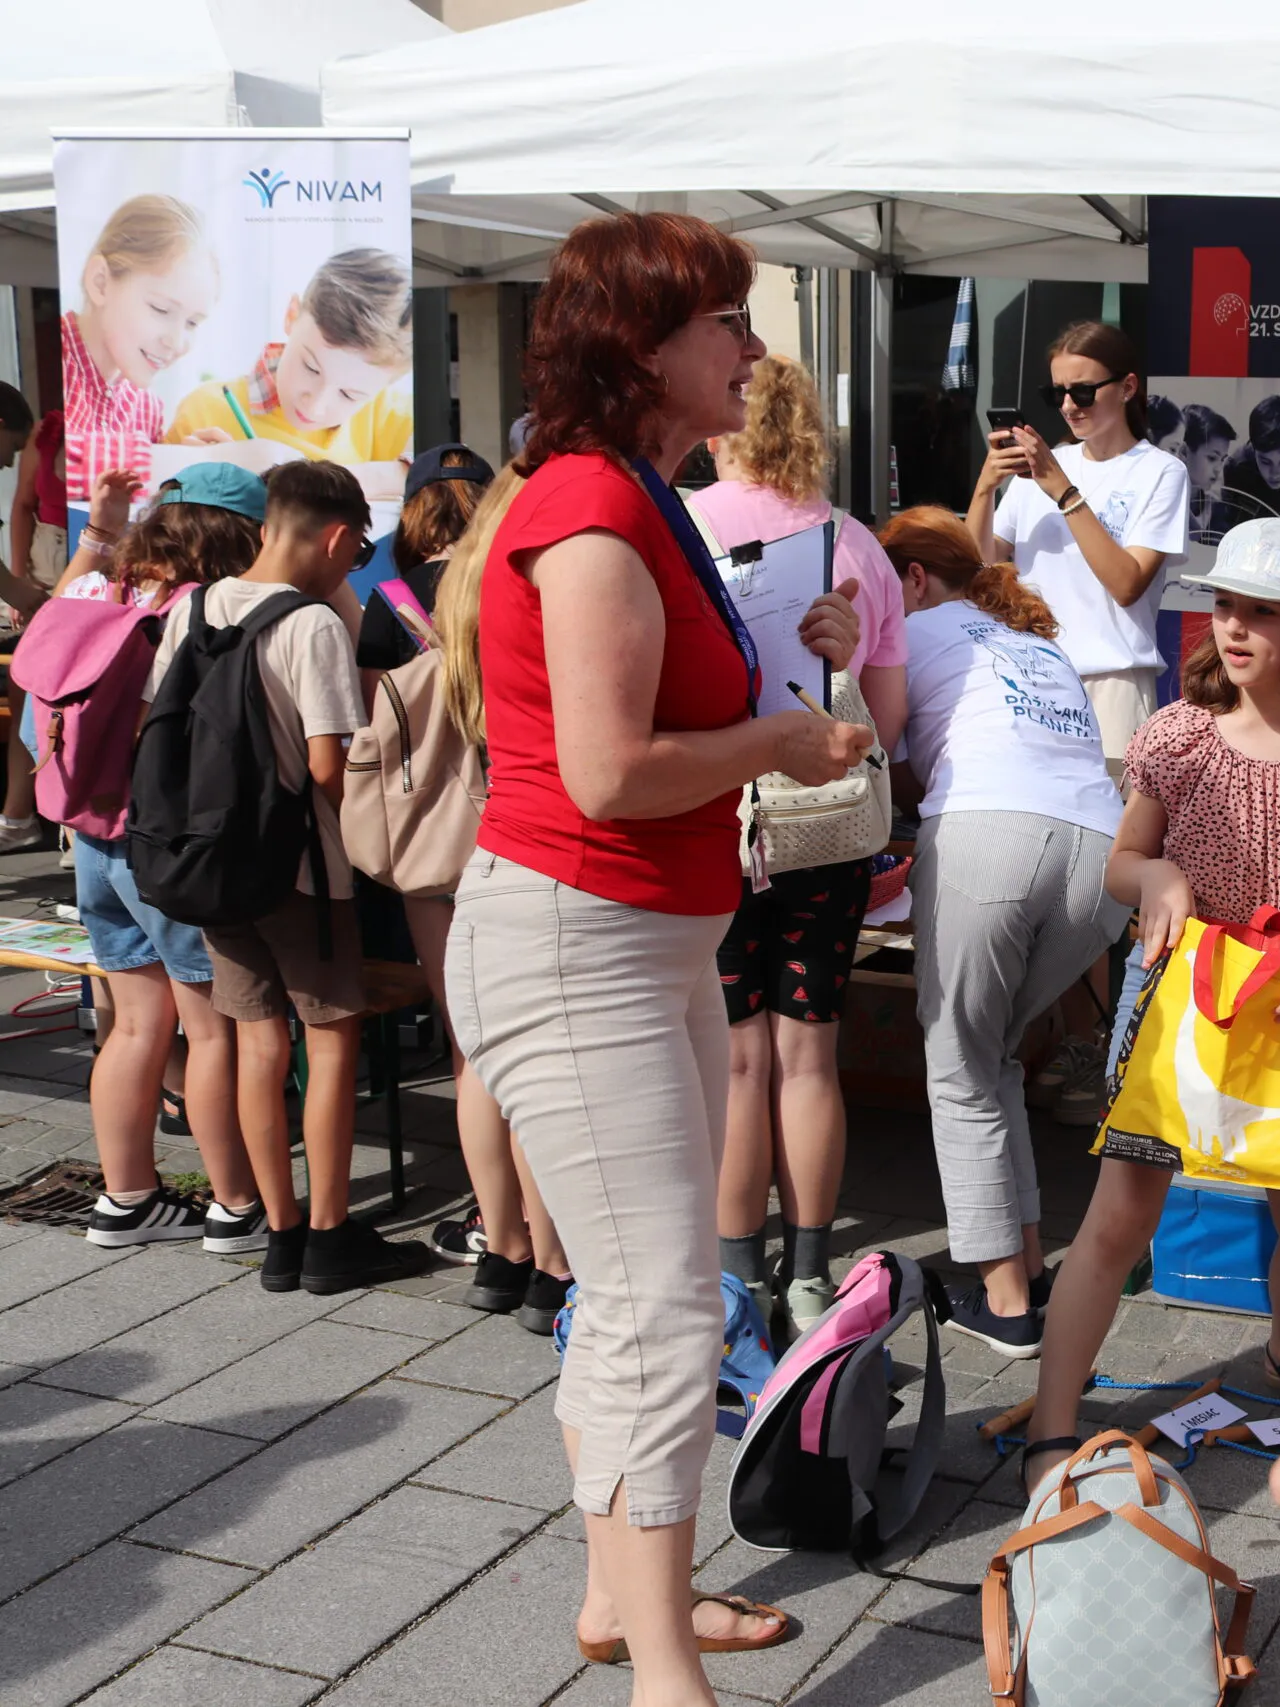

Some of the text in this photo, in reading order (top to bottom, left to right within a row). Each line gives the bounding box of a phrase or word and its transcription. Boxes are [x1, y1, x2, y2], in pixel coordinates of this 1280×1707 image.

[297, 180, 382, 202] NIVAM
[1250, 322, 1270, 337] 21.
[1180, 1407, 1221, 1431] 1 MESIAC
